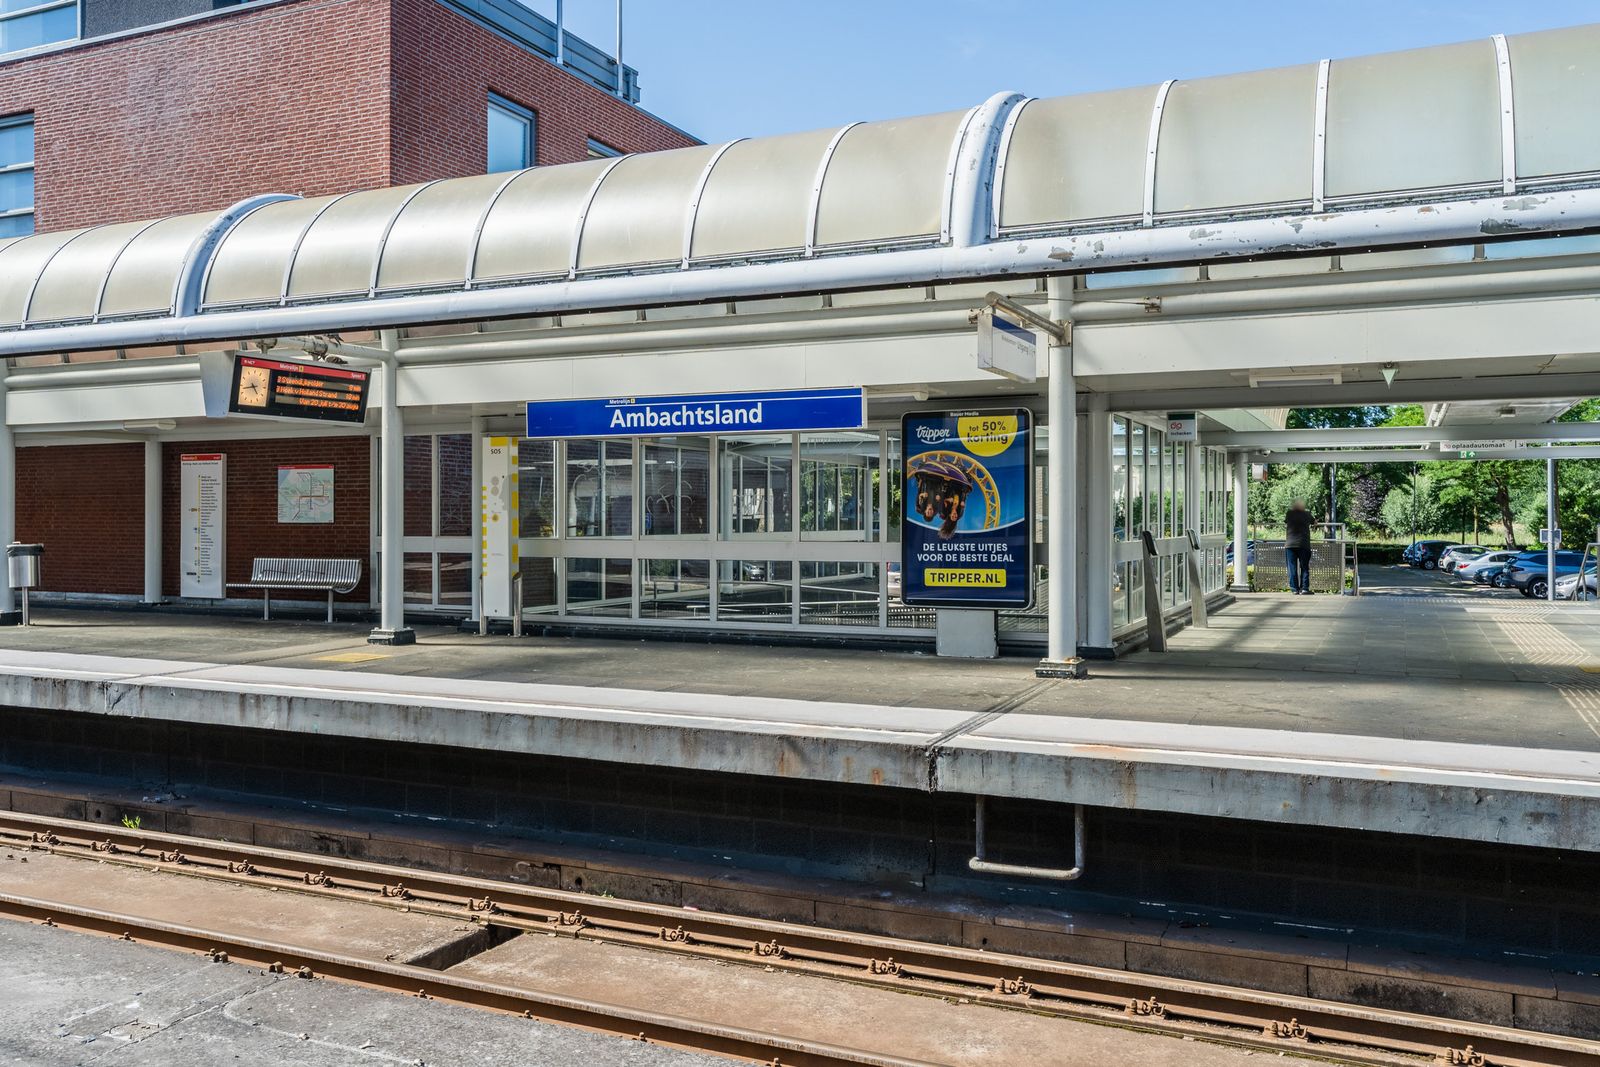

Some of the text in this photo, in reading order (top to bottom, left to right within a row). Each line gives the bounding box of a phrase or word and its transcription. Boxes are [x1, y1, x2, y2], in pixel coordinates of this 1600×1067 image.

[609, 402, 763, 428] Ambachtsland
[982, 421, 1006, 431] 50%
[916, 425, 951, 440] tripper
[967, 432, 1008, 444] korting
[923, 543, 1008, 552] DE LEUKSTE UITJES
[917, 554, 1014, 562] VOOR DE BESTE DEAL
[930, 572, 1001, 584] TRIPPER.NL
